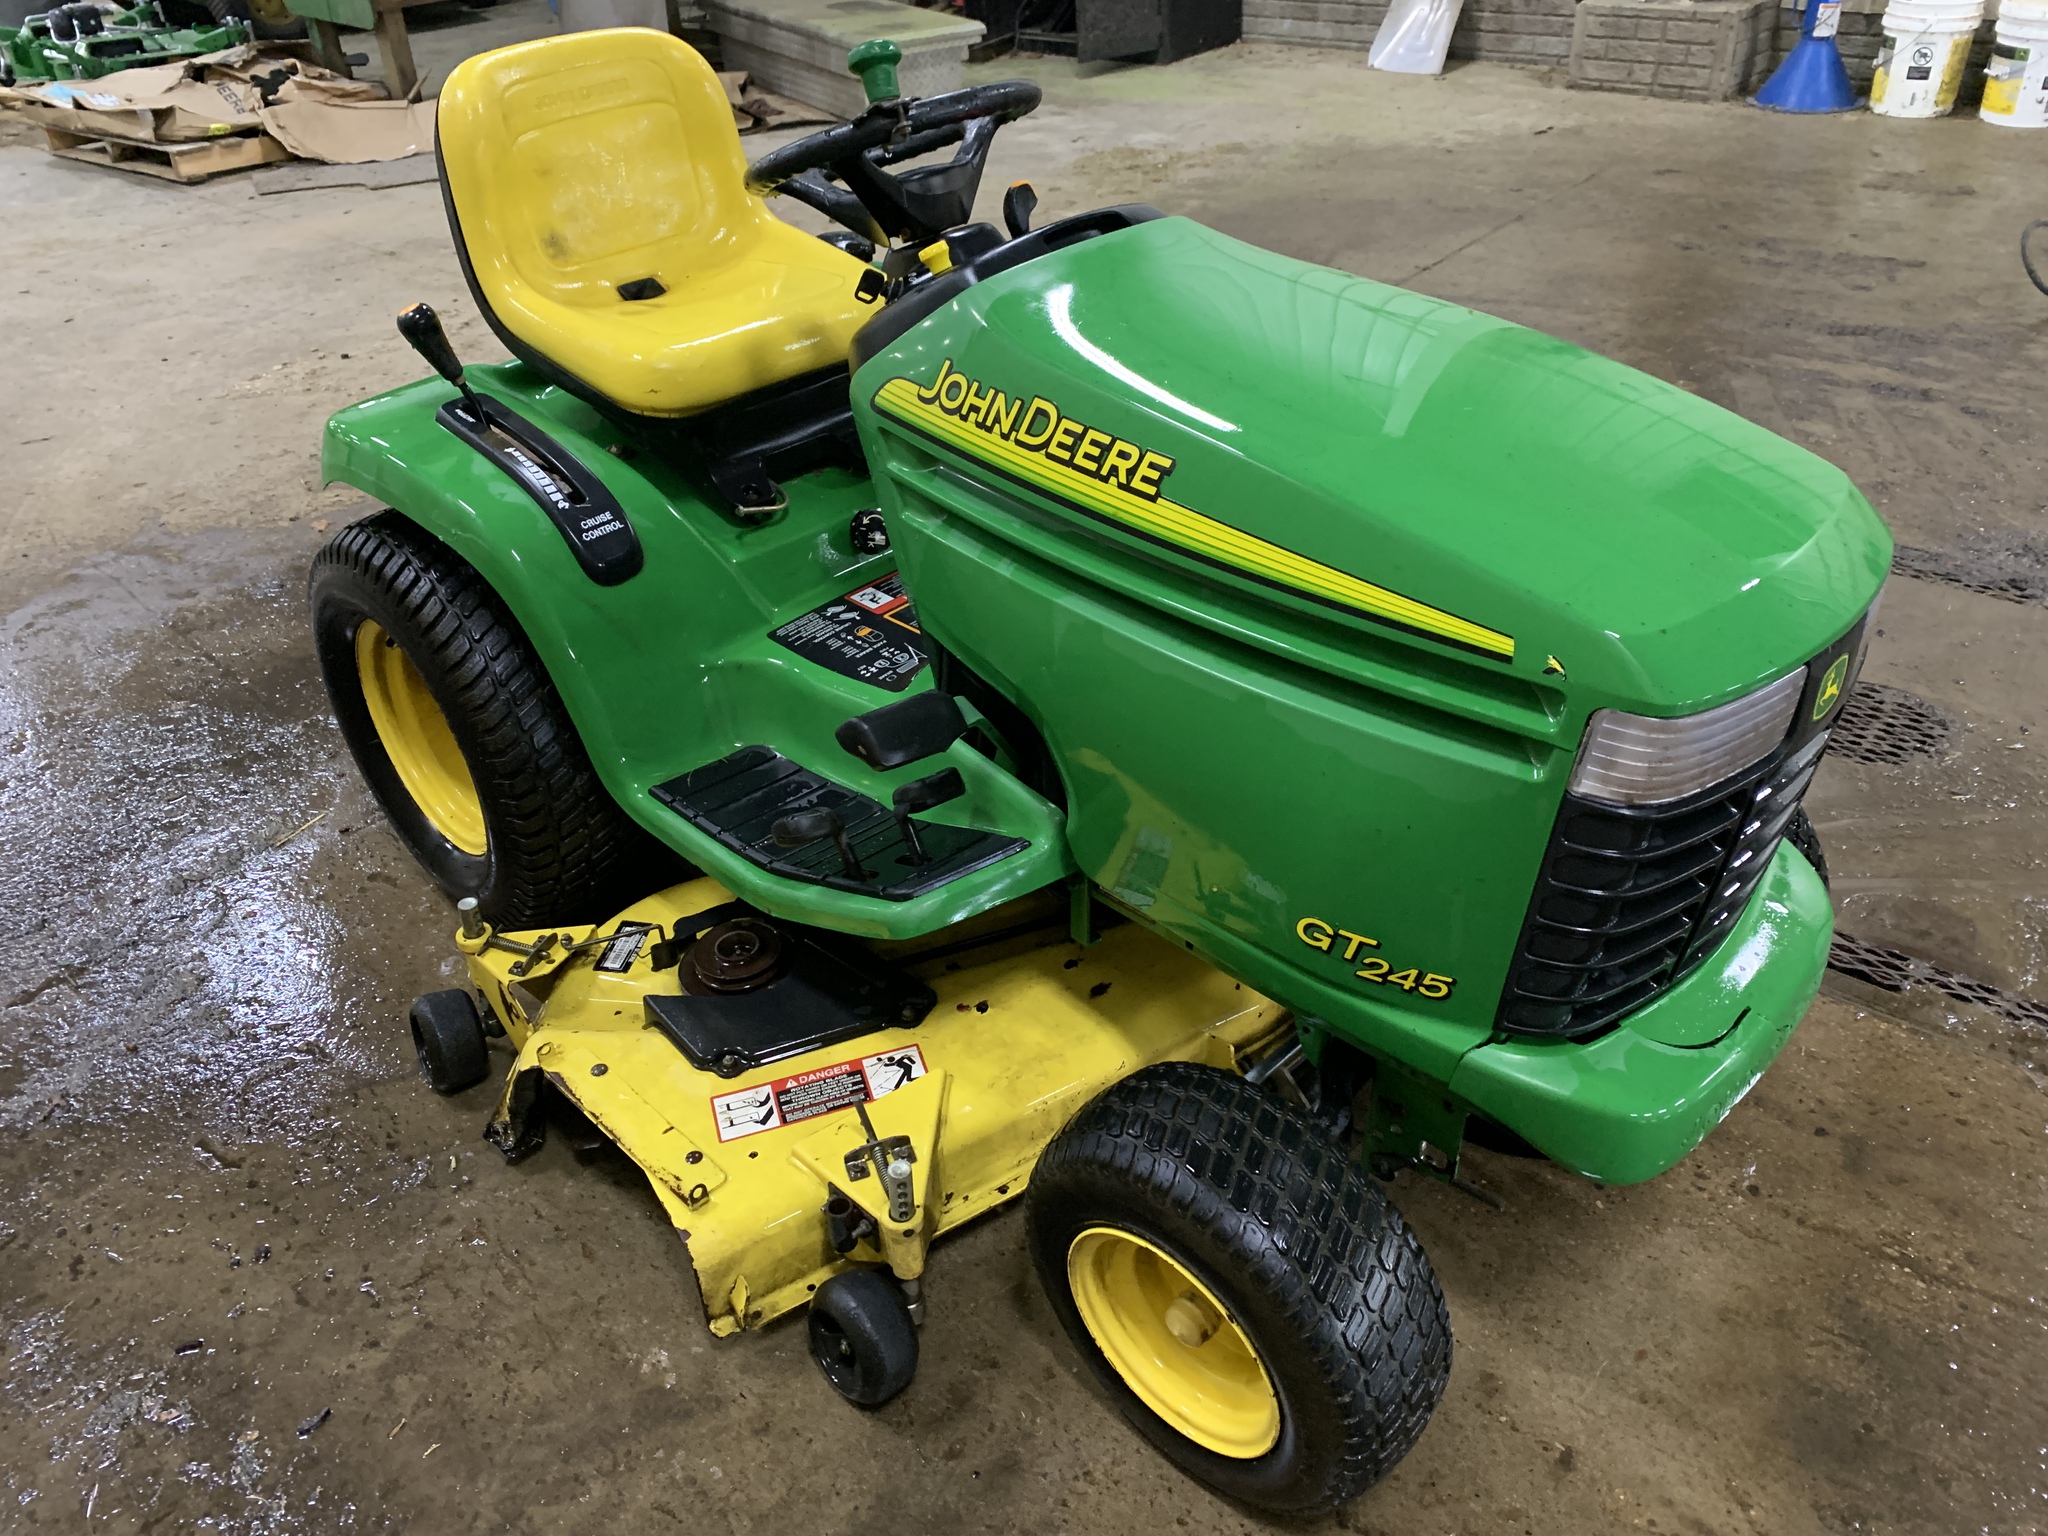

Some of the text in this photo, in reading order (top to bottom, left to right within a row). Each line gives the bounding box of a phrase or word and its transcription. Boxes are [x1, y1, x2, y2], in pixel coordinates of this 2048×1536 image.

[918, 358, 1174, 499] JOHN DEERE
[580, 510, 613, 529] CRUISE
[582, 520, 625, 542] CONTROL
[798, 1064, 851, 1084] DANGER
